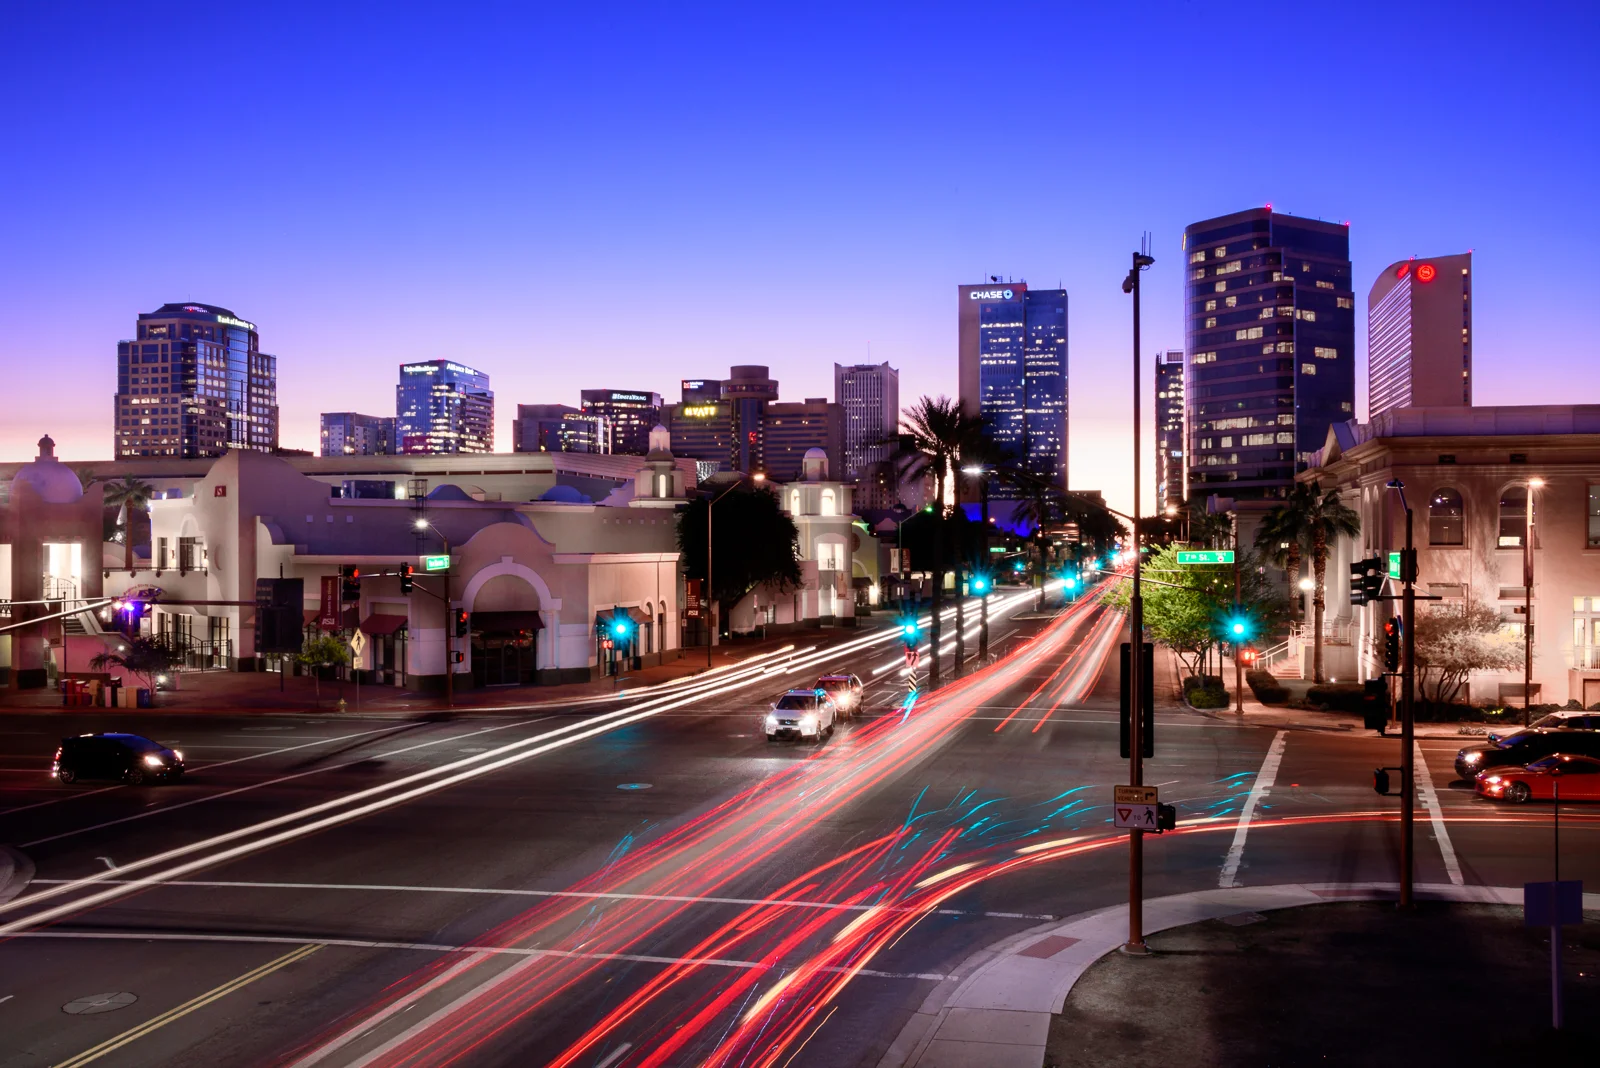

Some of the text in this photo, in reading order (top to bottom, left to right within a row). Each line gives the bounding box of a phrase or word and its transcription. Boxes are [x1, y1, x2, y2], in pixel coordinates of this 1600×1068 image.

[970, 291, 1003, 300] CHASE
[446, 363, 465, 373] Alliance
[684, 406, 716, 417] HYATT
[1198, 553, 1210, 562] St.
